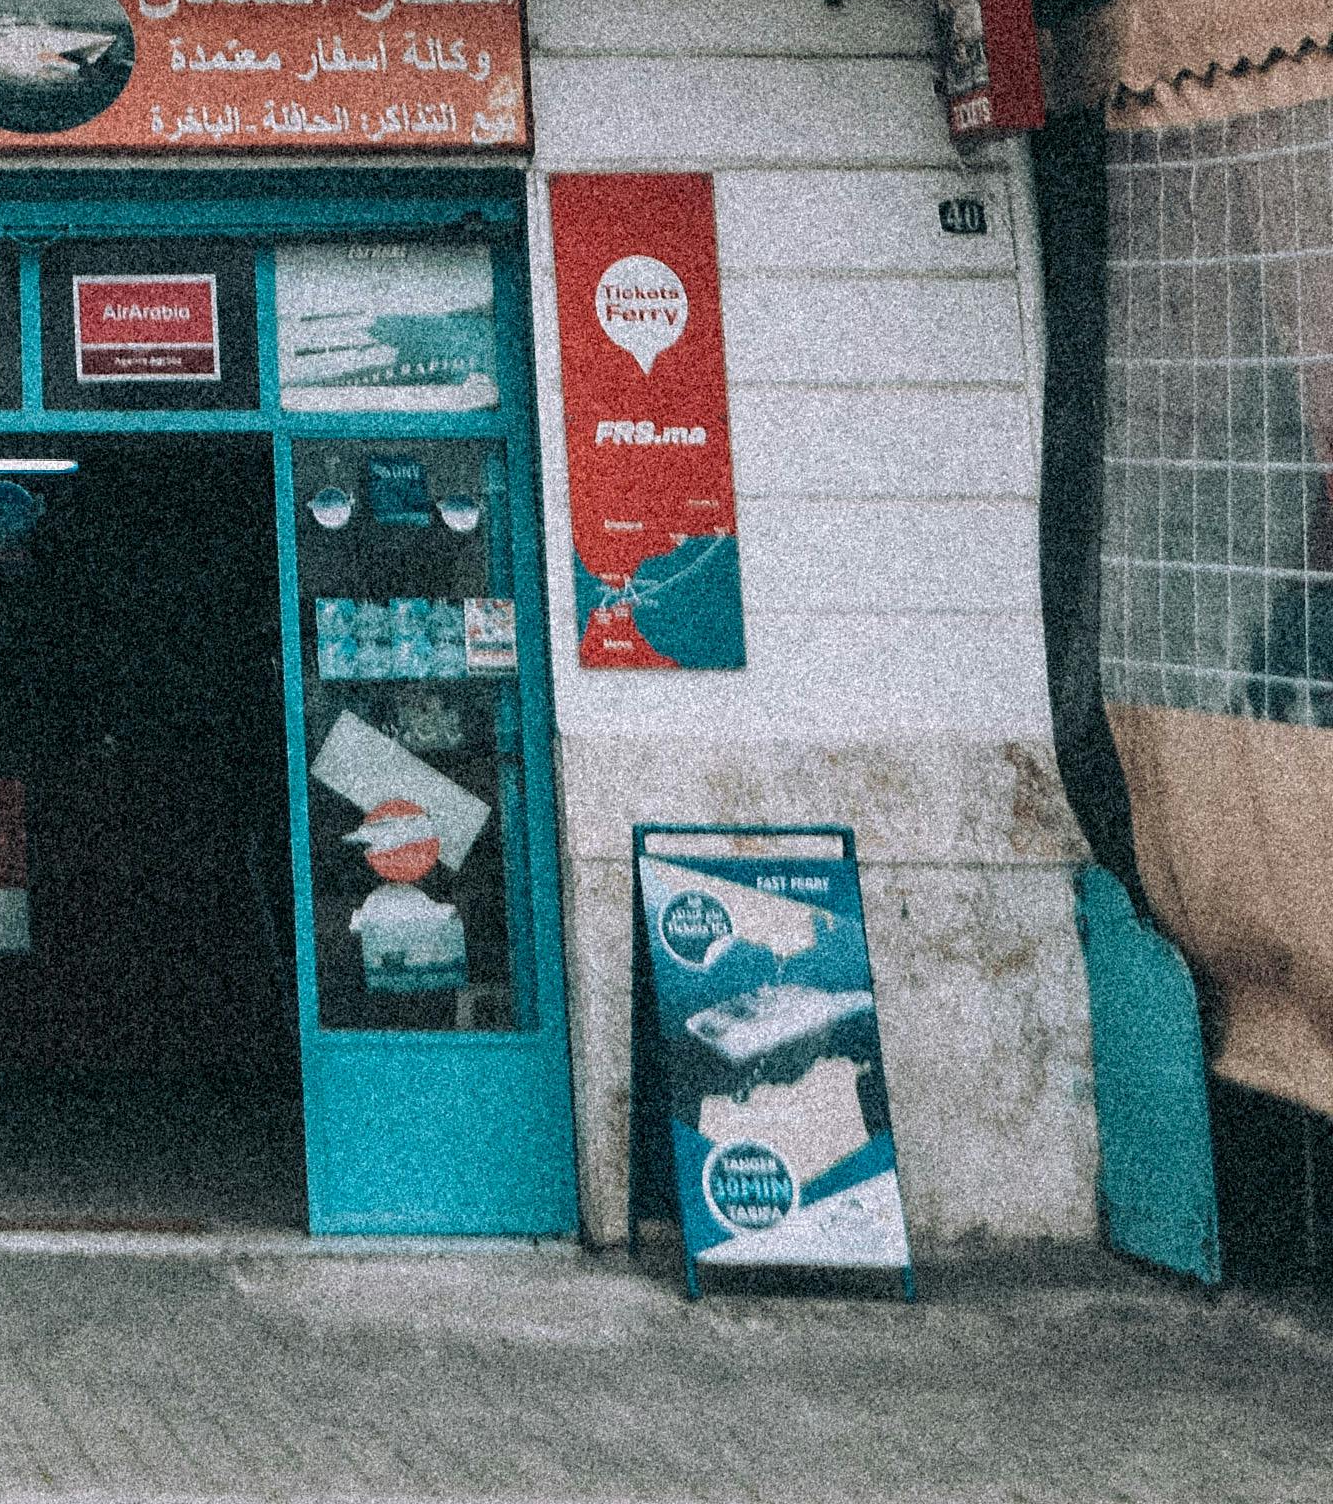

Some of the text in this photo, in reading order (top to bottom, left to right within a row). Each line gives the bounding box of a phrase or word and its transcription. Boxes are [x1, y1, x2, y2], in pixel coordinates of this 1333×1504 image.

[169, 35, 282, 73] معتمدة
[403, 31, 493, 83] وكالة
[947, 200, 979, 232] 40
[604, 285, 680, 300] Tickets
[102, 303, 190, 322] AirArabia
[606, 303, 679, 326] Ferry
[596, 420, 708, 446] FRS.ma
[757, 875, 786, 891] FAST
